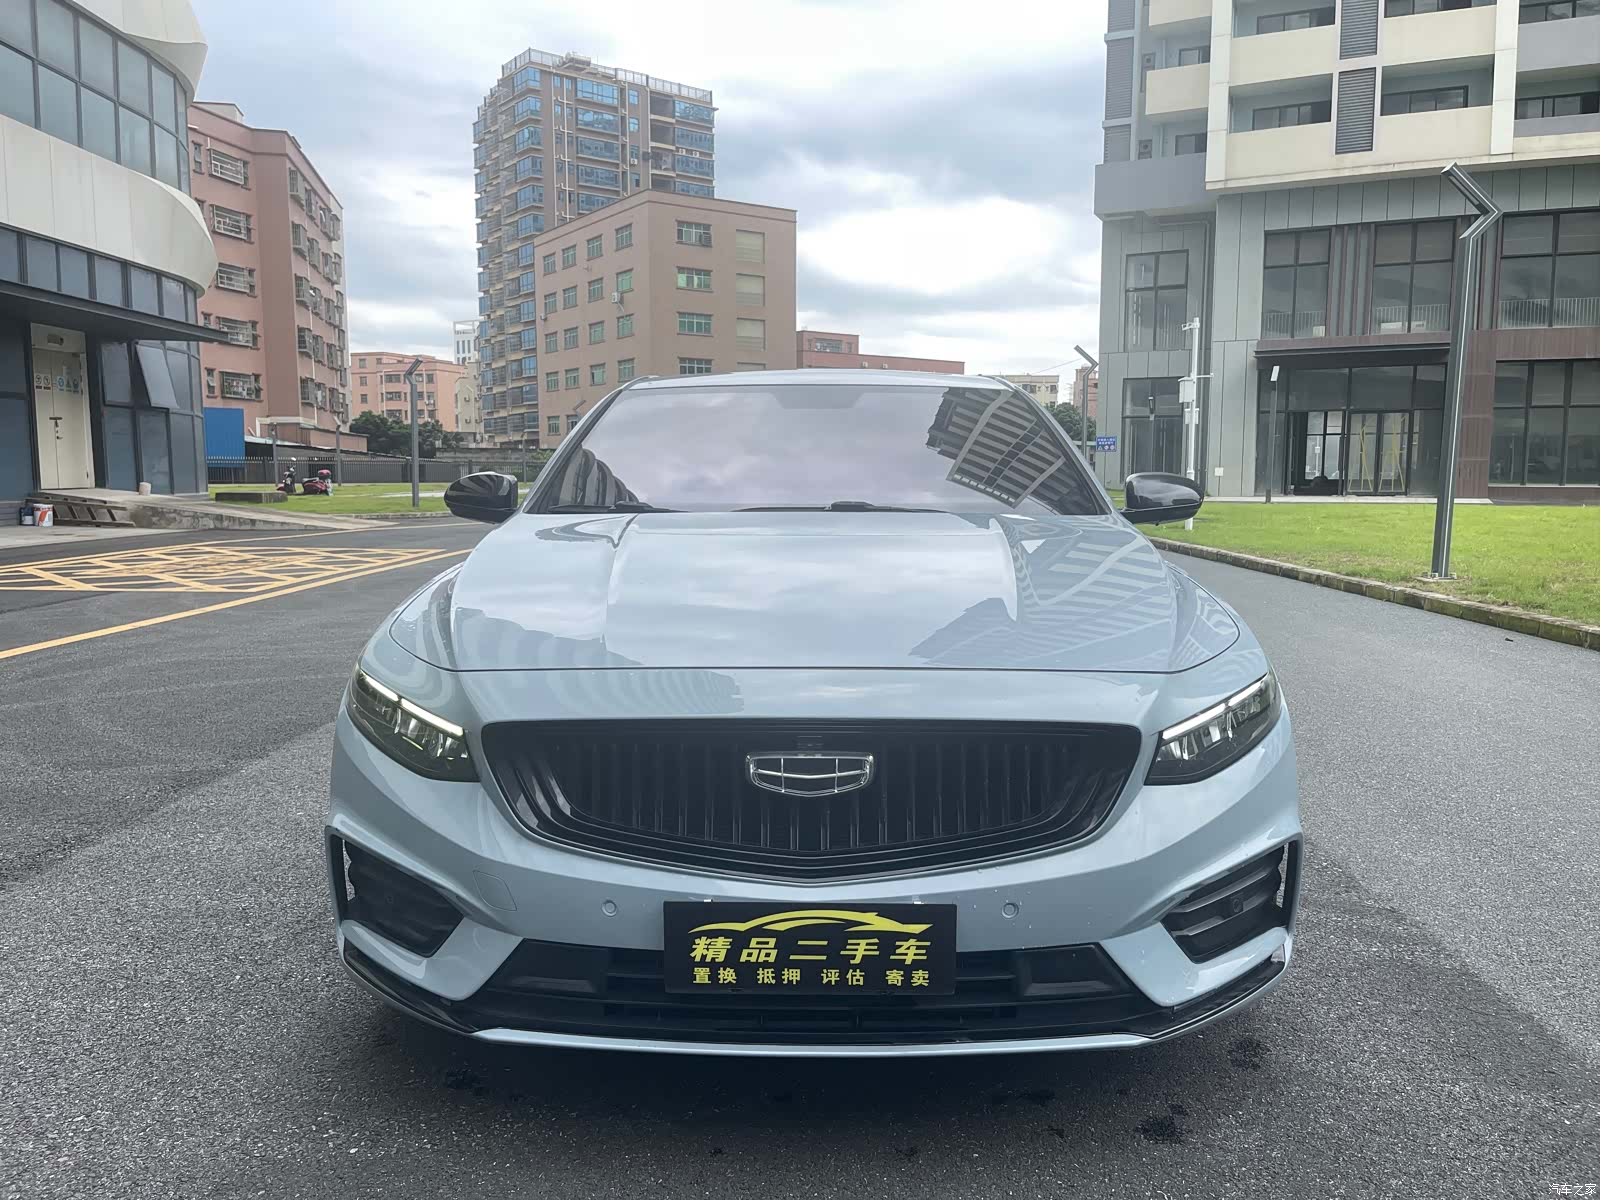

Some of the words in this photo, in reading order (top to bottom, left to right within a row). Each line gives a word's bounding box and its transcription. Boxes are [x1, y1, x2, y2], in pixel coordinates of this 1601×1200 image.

[691, 936, 931, 964] 精品二手车
[693, 967, 737, 985] 置换
[757, 968, 801, 985] 抵押
[821, 969, 865, 986] 评估
[885, 970, 929, 987] 寄卖
